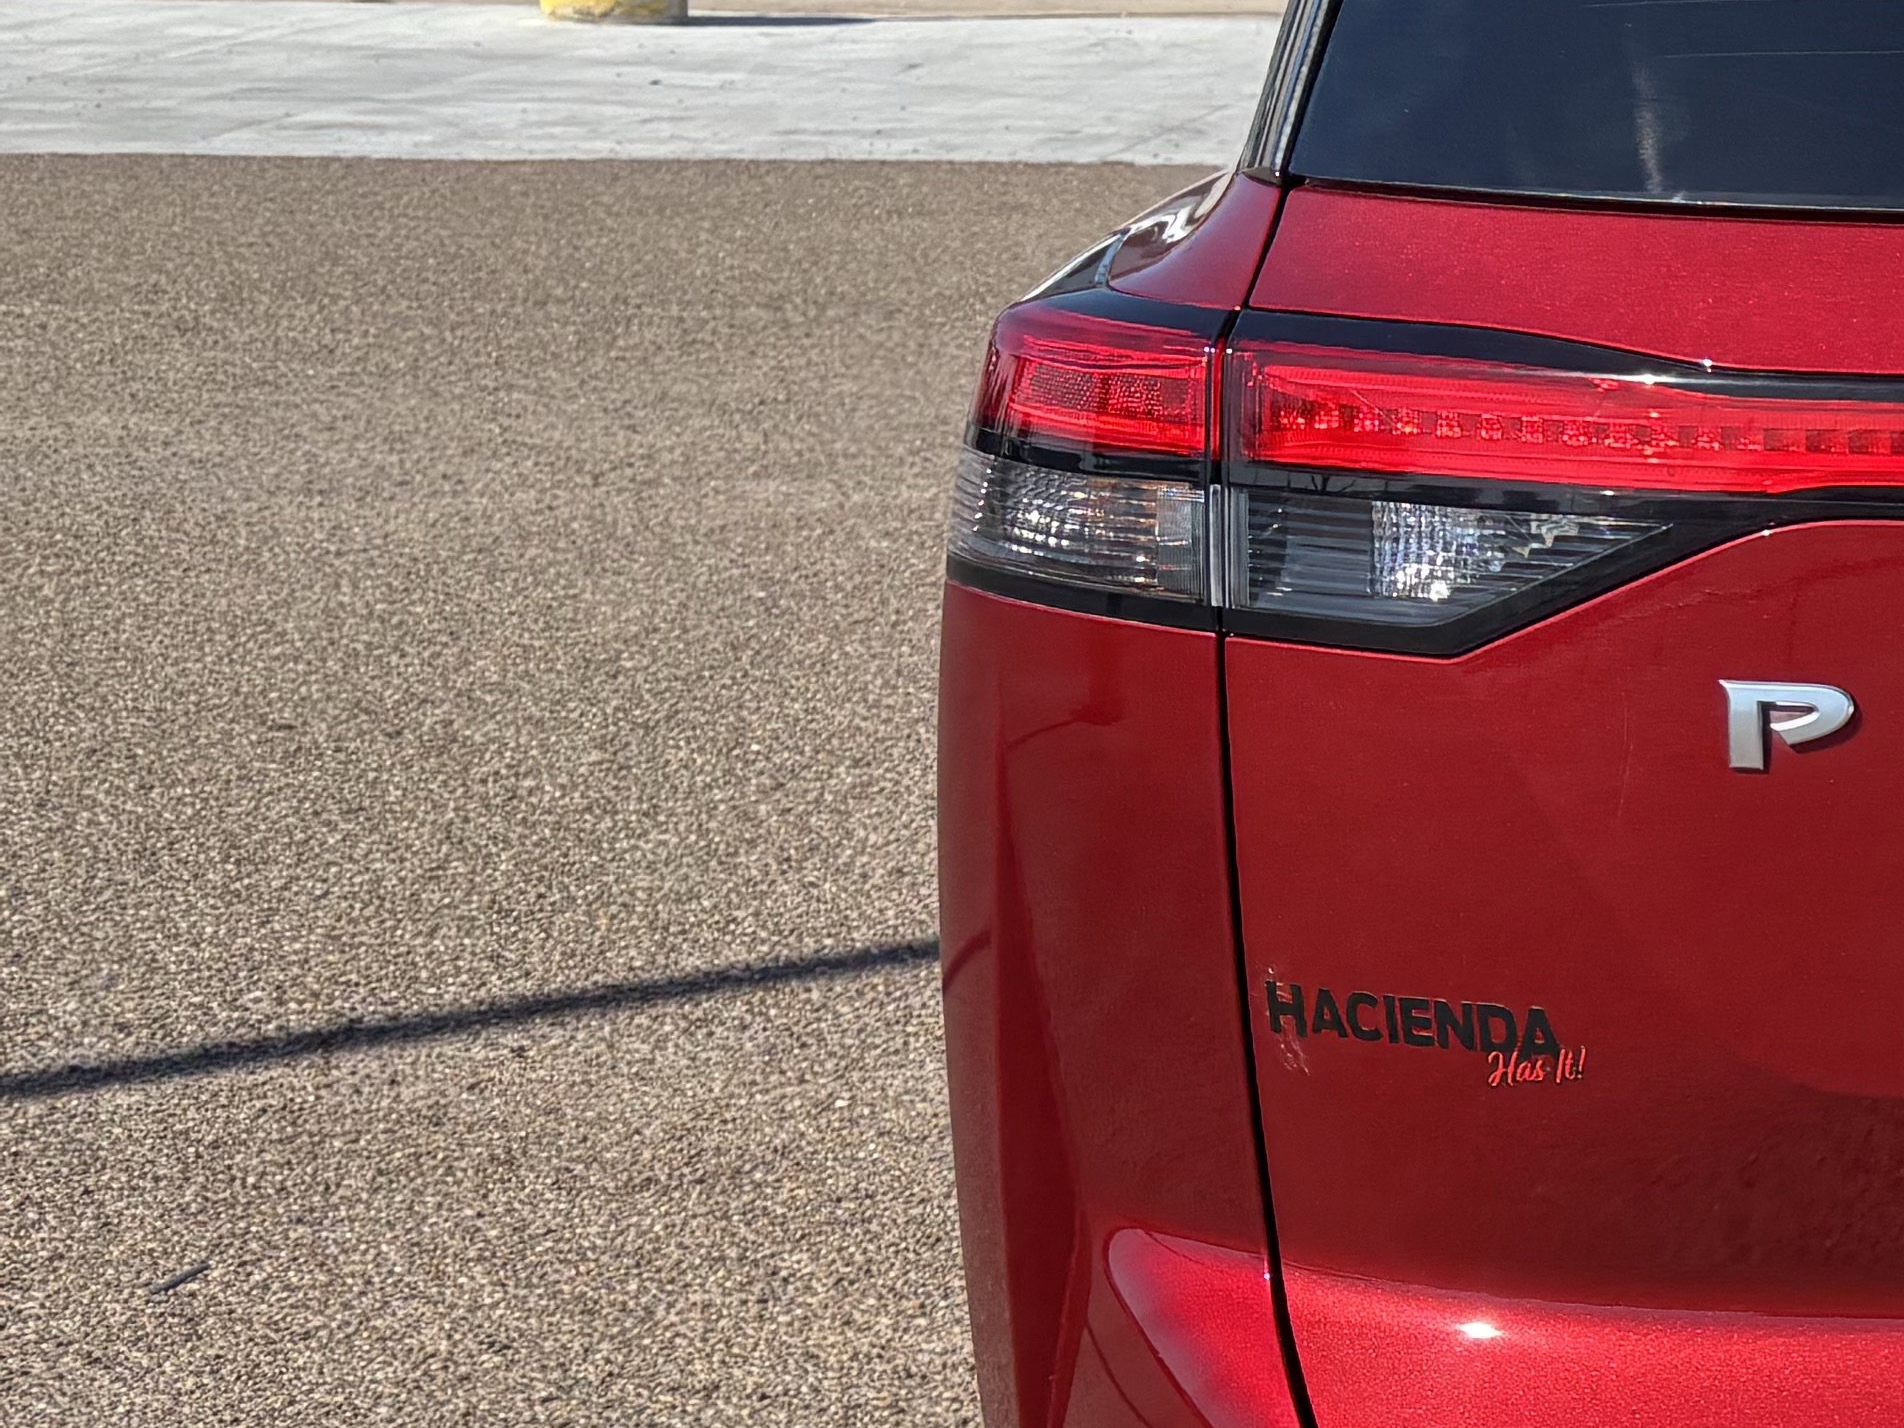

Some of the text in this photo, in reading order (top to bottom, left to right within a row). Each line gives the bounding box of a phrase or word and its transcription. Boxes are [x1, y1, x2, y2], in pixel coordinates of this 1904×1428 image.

[1264, 980, 1562, 1058] HACIENDA
[1487, 1045, 1588, 1088] Has It!
